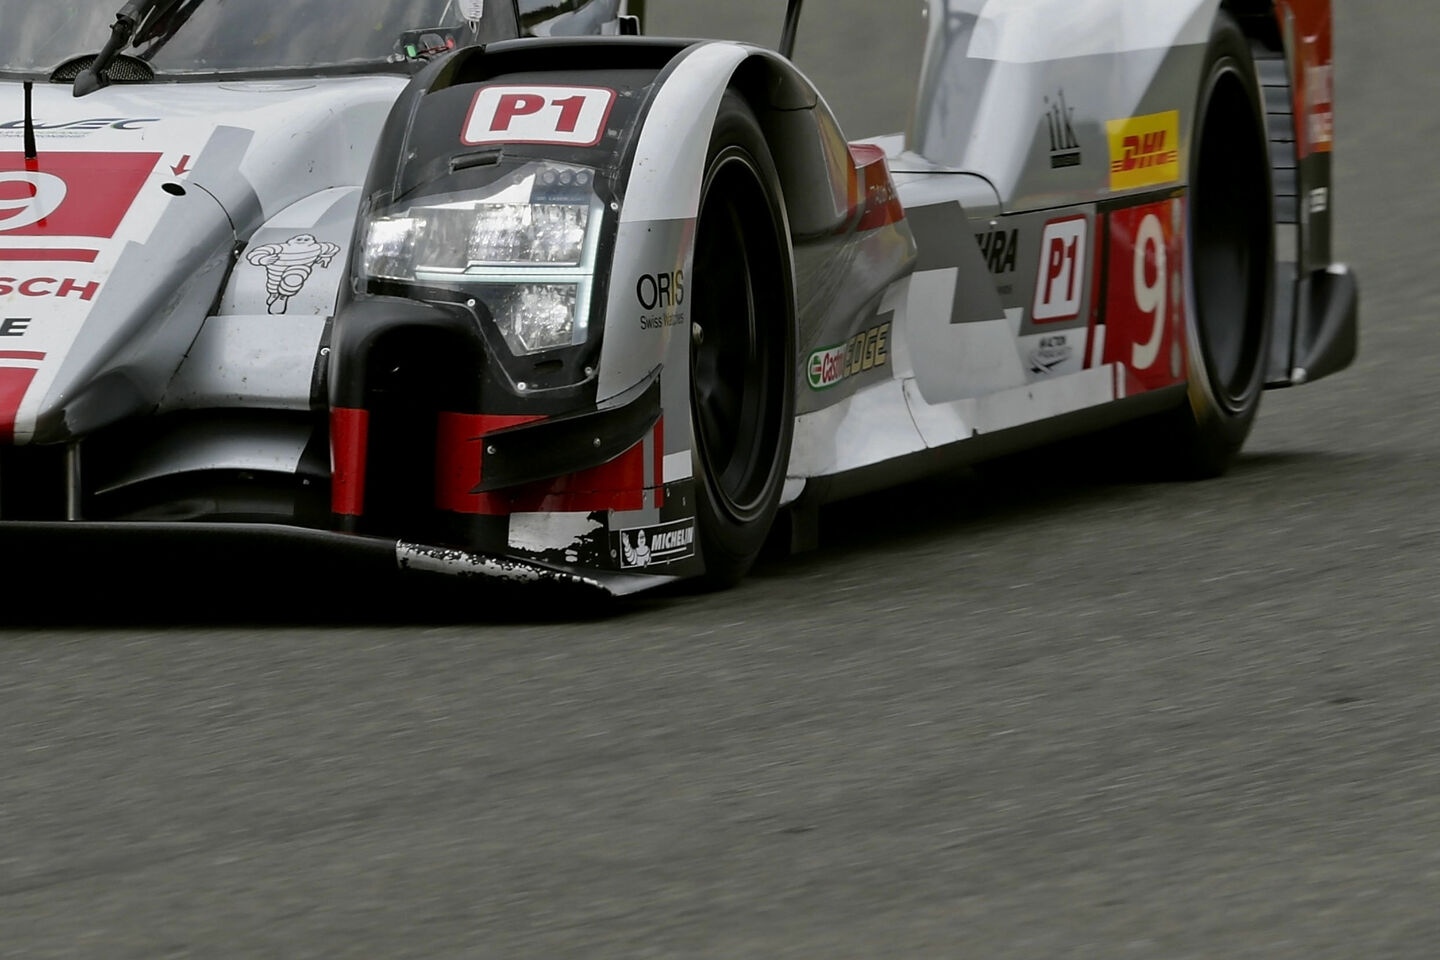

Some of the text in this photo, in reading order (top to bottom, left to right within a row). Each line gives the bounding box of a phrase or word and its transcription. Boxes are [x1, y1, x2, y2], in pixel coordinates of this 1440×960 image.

[489, 93, 588, 132] P1
[1122, 130, 1168, 172] DHL
[636, 269, 684, 310] ORIS
[1042, 235, 1080, 305] P1
[1131, 213, 1167, 370] 9
[640, 313, 663, 330] Swiss
[843, 320, 892, 380] EDGE
[651, 526, 695, 552] MICHELIN
